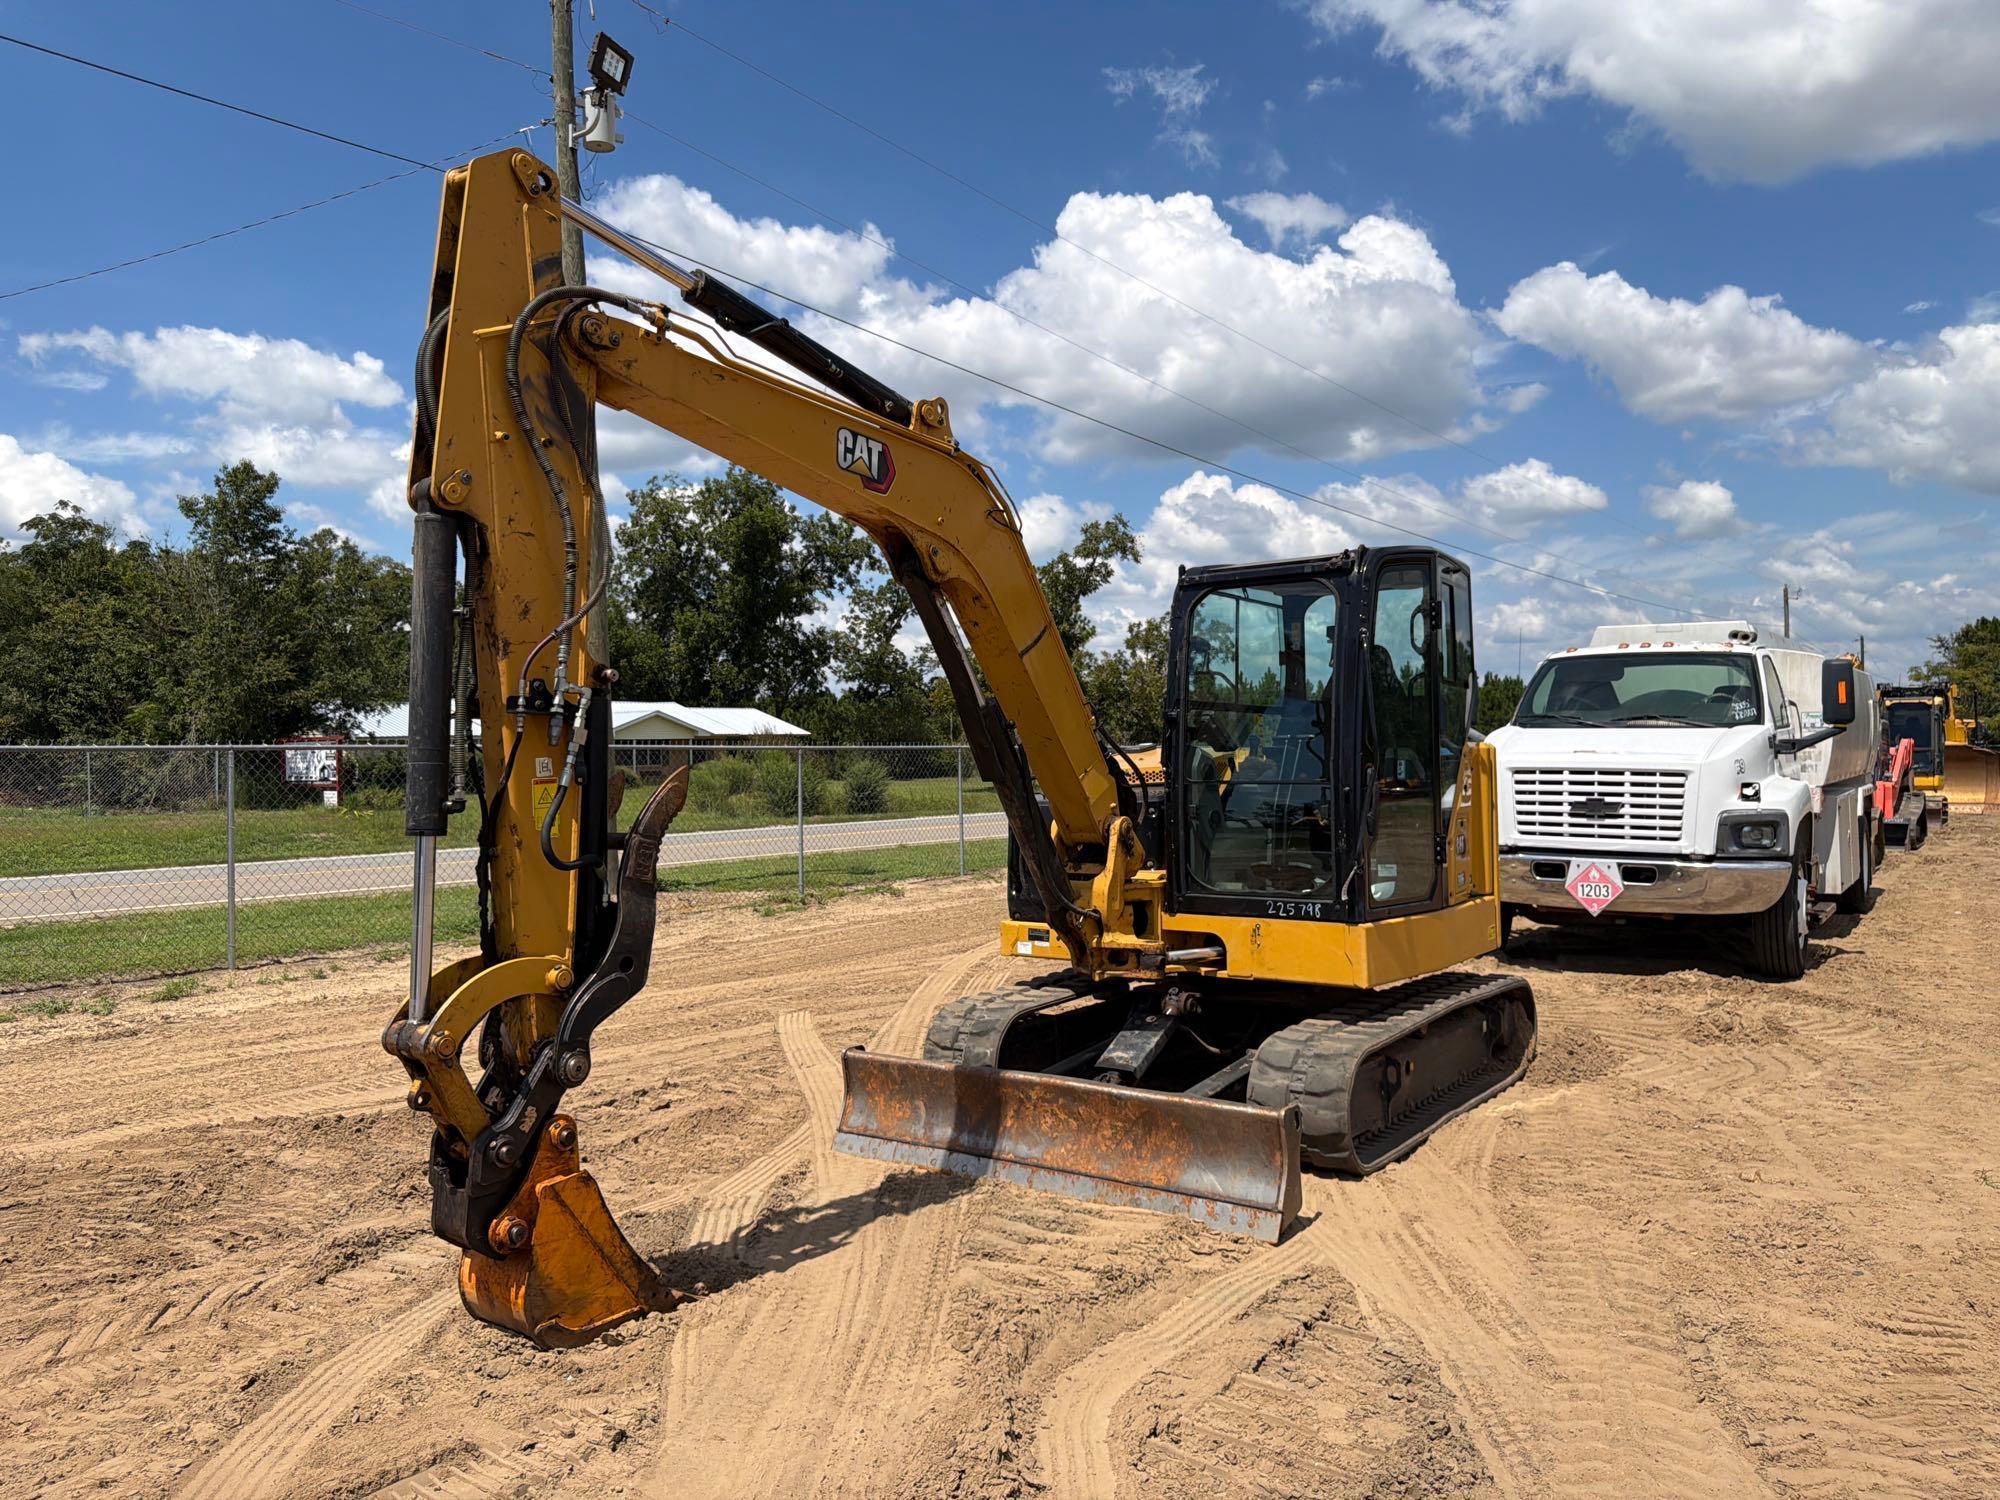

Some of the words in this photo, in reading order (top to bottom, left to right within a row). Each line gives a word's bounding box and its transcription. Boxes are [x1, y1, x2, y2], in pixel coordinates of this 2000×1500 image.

[838, 428, 883, 480] CAT
[1580, 883, 1610, 898] 1203
[1266, 900, 1322, 918] 225798
[1591, 902, 1598, 912] 3
